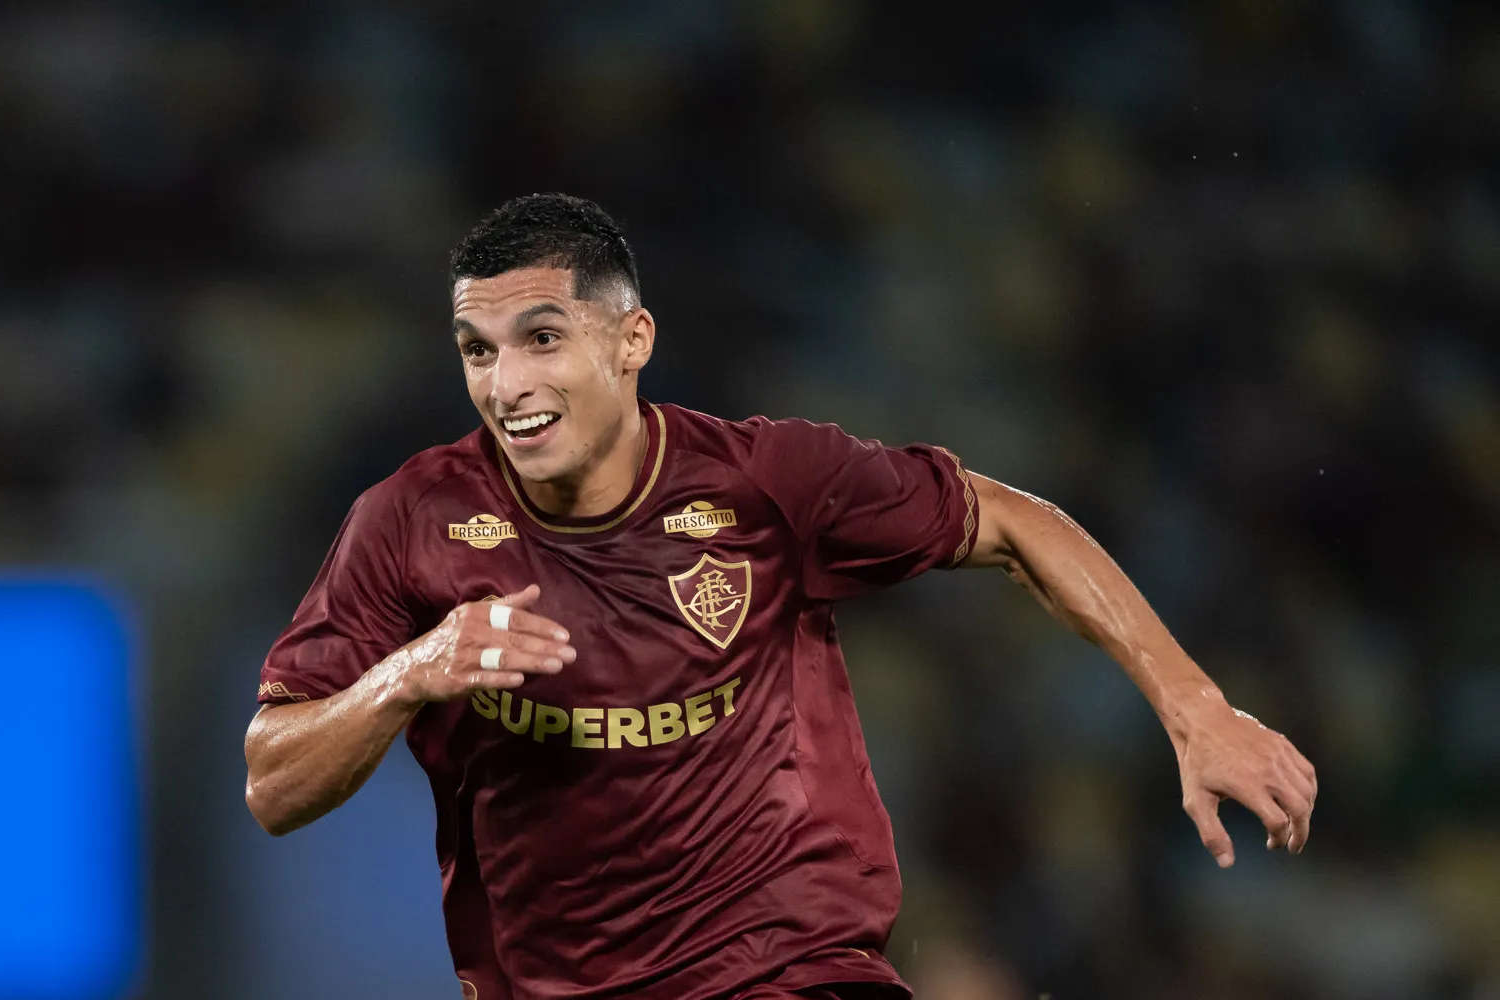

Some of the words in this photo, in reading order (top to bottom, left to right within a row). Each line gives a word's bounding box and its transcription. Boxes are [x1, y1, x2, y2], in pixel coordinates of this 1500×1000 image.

[667, 512, 733, 530] FRESCATTO
[452, 524, 517, 538] FRESCATTO
[471, 676, 741, 749] SUPERBET
